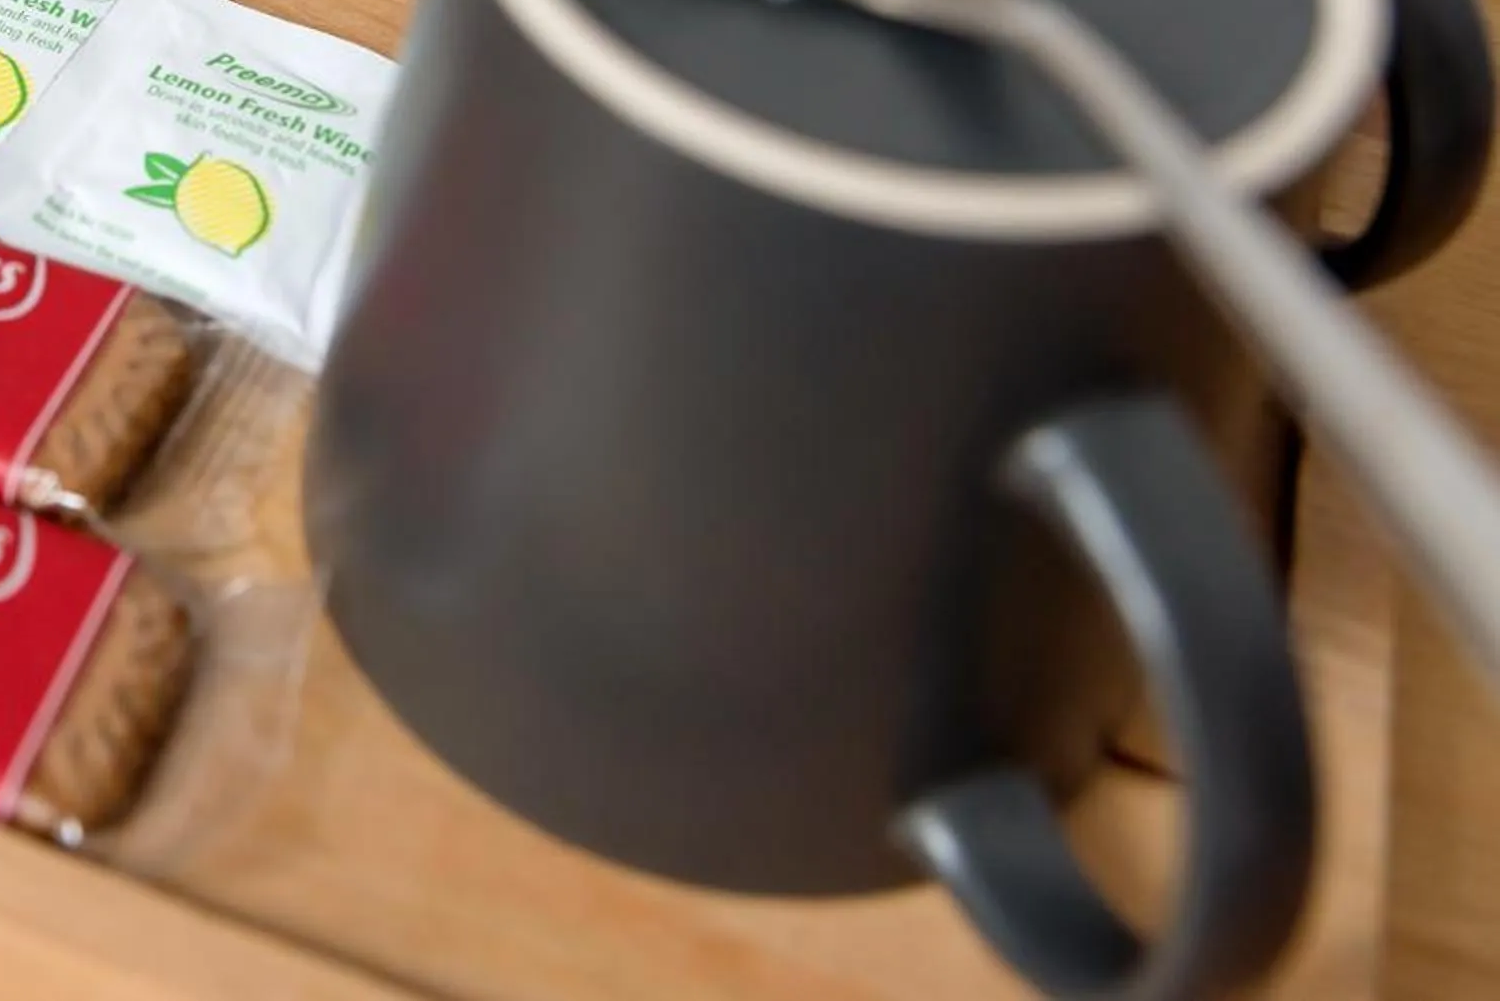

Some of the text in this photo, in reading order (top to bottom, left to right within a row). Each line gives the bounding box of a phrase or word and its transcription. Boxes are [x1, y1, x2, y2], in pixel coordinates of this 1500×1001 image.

[32, 10, 64, 34] and
[26, 30, 64, 54] fresh
[205, 52, 322, 105] Preema
[149, 64, 233, 104] Lemon
[237, 96, 307, 133] Fresh
